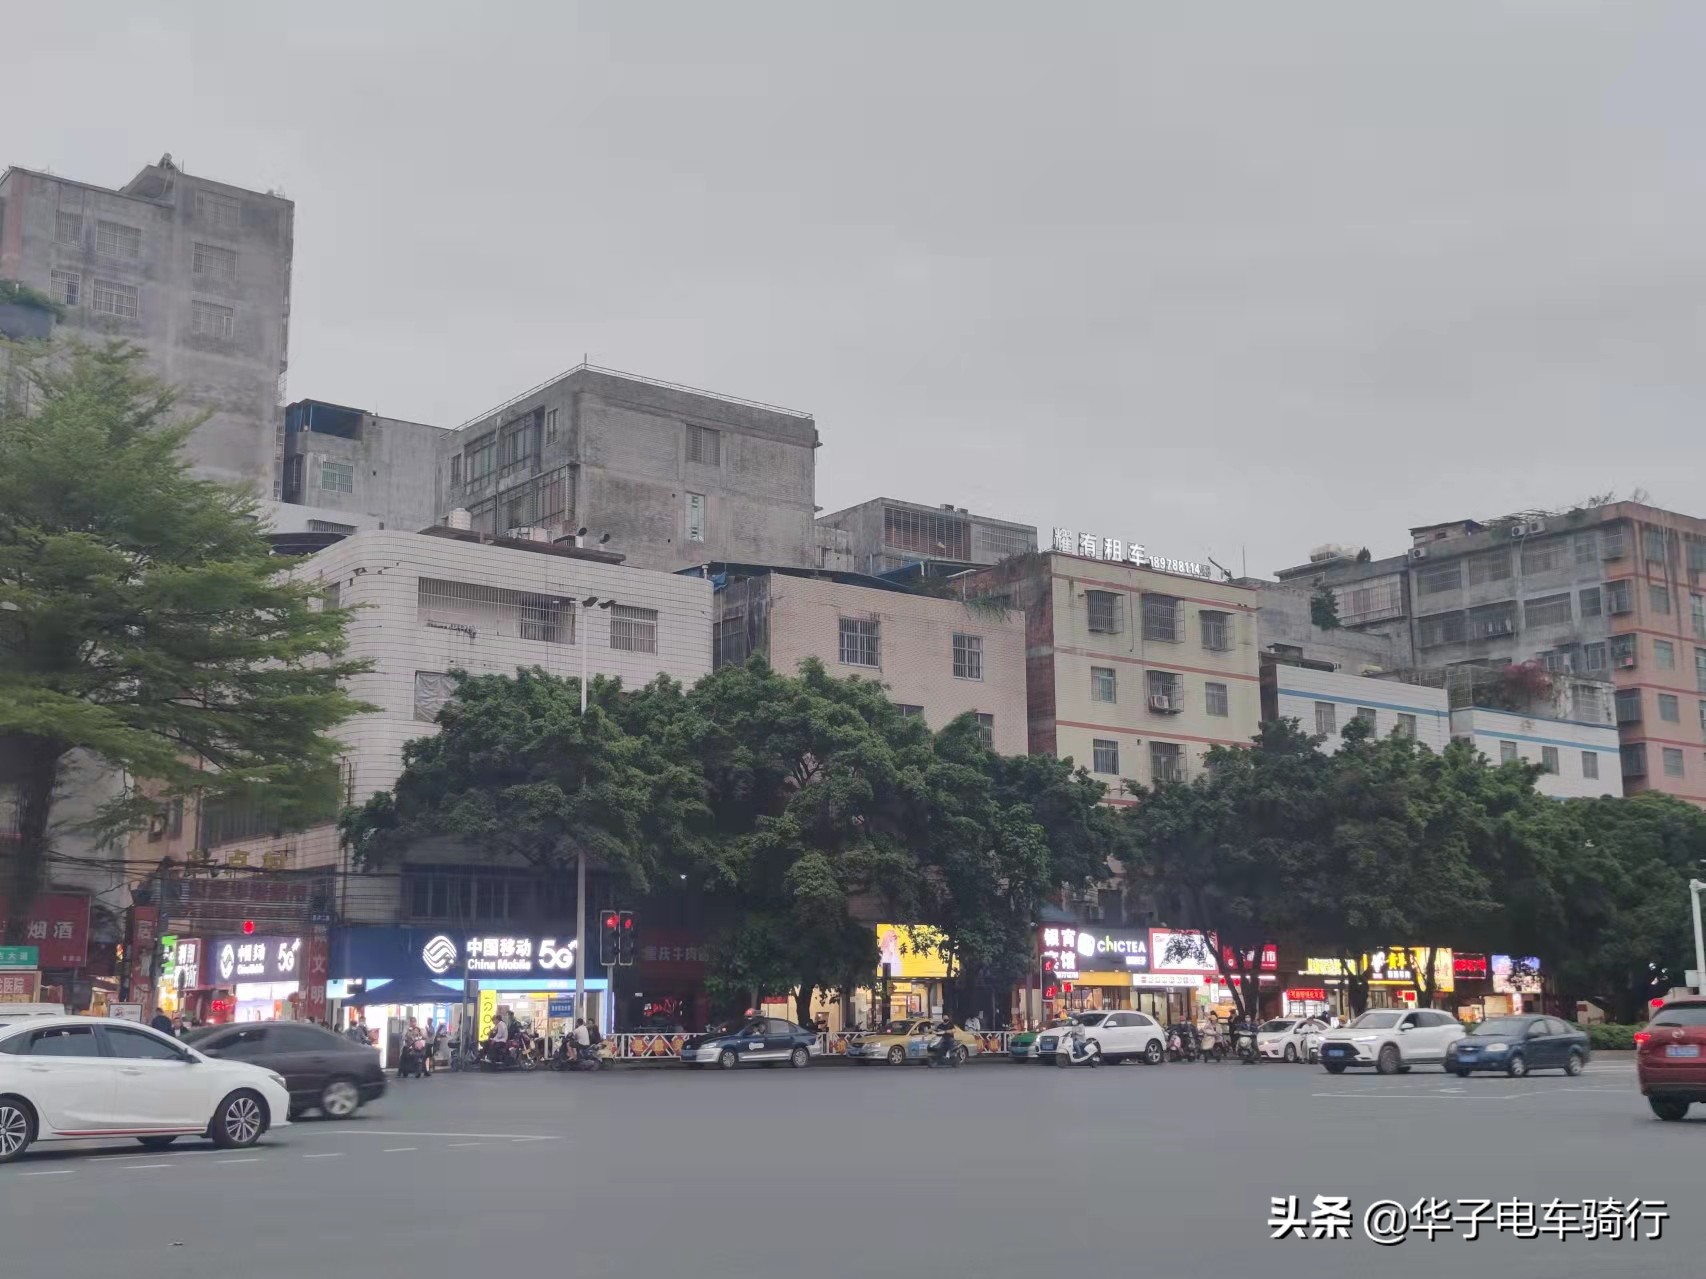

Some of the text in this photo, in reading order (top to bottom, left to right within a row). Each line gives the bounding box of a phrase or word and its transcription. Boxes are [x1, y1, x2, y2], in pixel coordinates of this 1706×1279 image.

[27, 921, 74, 939] 烟酒
[467, 938, 532, 957] 中国移动
[538, 940, 574, 969] 5G
[467, 958, 531, 970] China Mobile
